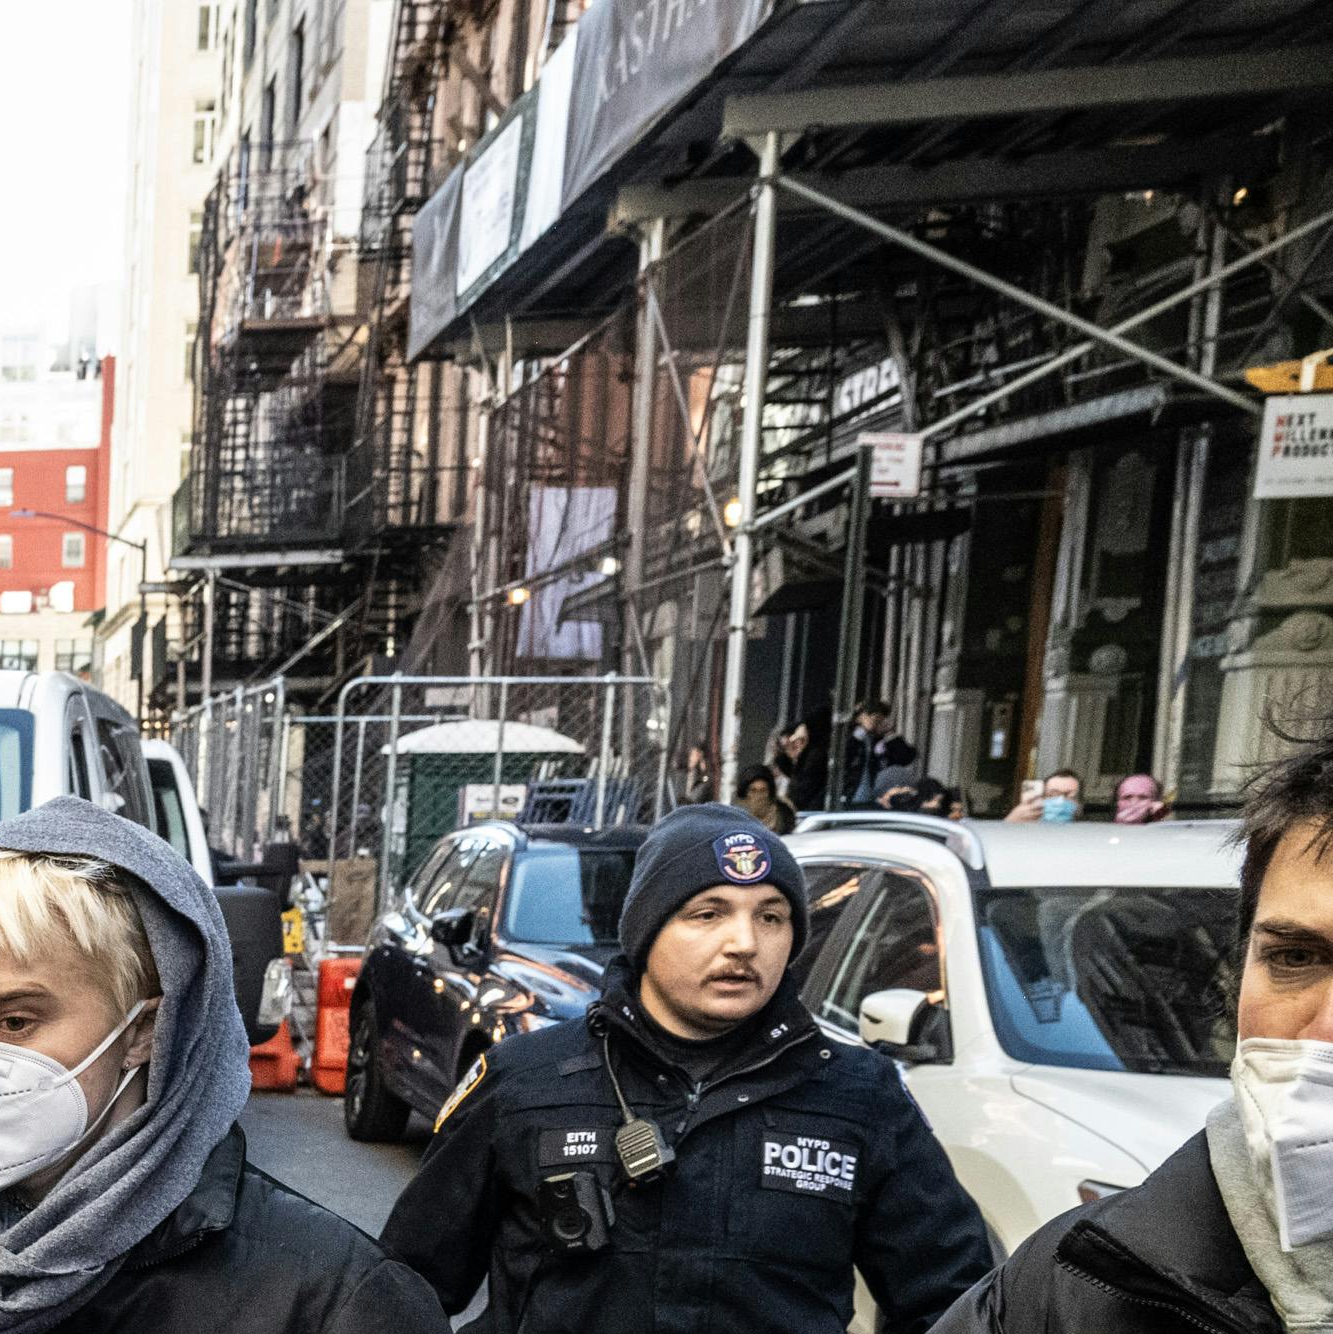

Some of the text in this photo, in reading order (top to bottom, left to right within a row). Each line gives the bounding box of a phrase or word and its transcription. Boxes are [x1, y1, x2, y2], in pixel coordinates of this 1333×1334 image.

[1275, 412, 1317, 428] NEXT
[724, 833, 755, 847] NYPD
[770, 1023, 789, 1039] S1
[566, 1131, 596, 1144] EITH
[797, 1137, 830, 1151] NYPD
[562, 1144, 598, 1157] 15107
[763, 1141, 857, 1181] POLICE
[763, 1165, 853, 1191] STRATEGIC RESPONSE
[795, 1179, 827, 1192] GROUP
